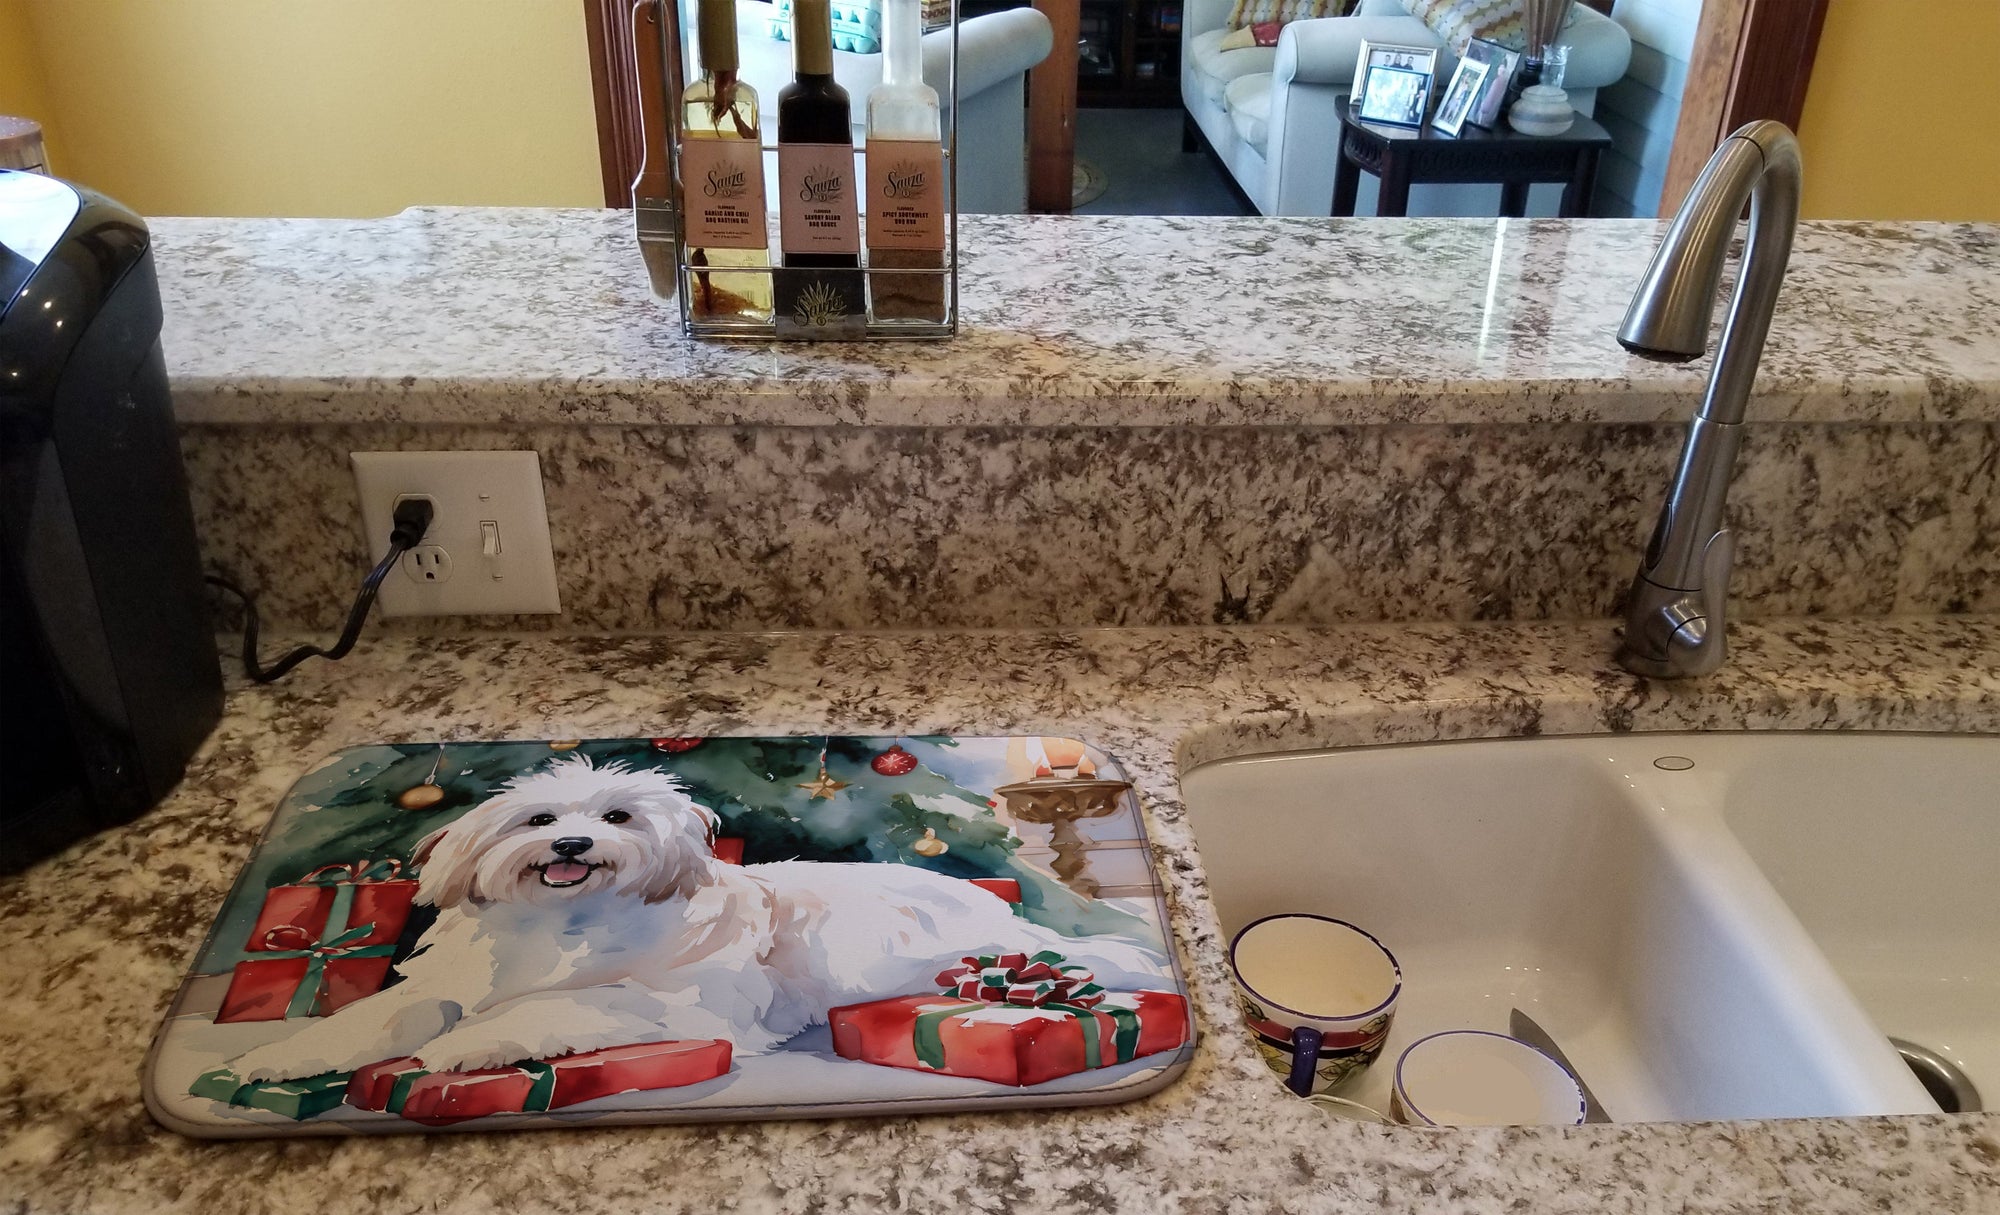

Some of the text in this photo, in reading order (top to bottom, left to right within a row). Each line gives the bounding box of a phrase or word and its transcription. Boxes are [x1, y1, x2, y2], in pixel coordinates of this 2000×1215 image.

[704, 171, 745, 197] Sauza
[800, 176, 841, 201] Sauza
[884, 172, 925, 197] Sauza
